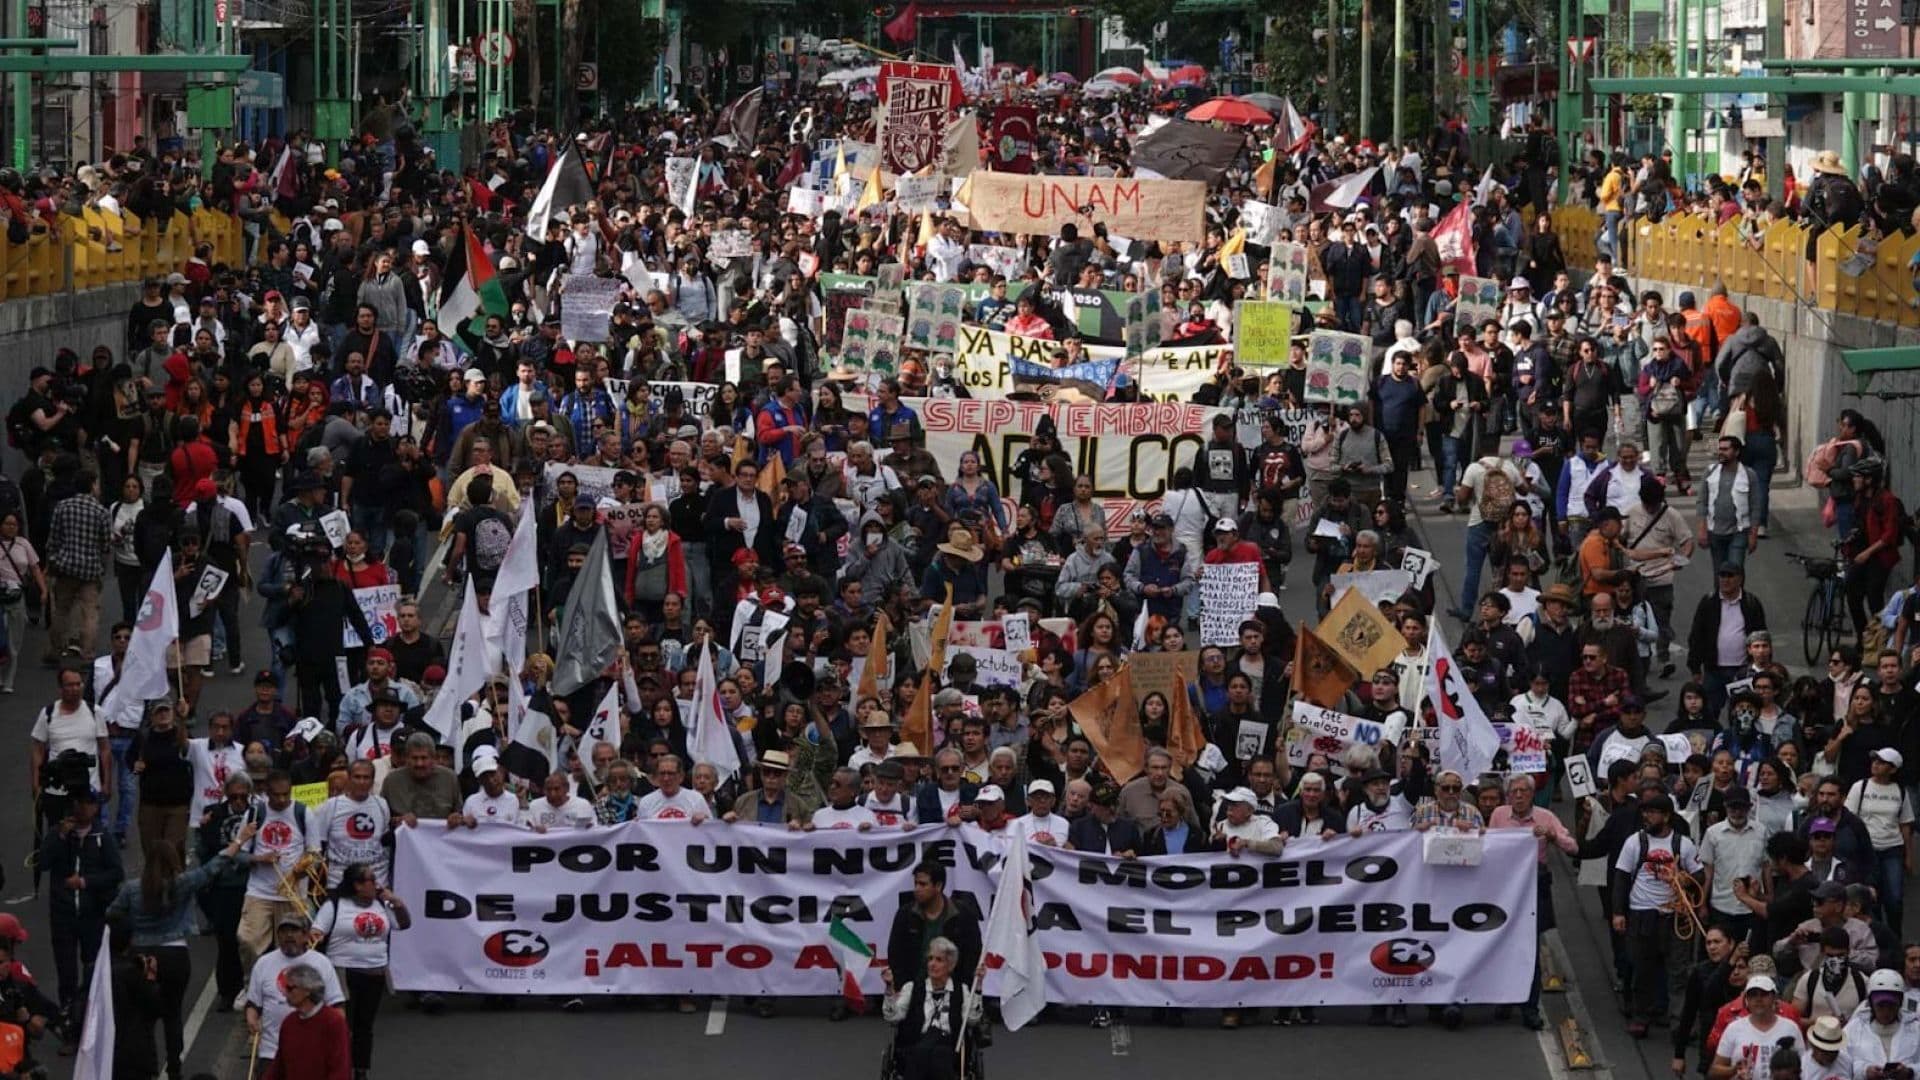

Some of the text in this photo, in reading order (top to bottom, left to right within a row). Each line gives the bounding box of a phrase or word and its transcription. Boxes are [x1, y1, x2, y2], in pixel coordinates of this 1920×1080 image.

[1023, 181, 1141, 218] UNAM
[961, 327, 994, 357] YA
[924, 400, 1211, 437] SEPTIEMBRE
[1353, 722, 1382, 747] NO
[511, 843, 661, 875] POR
[685, 845, 788, 875] UN
[1078, 855, 1399, 890] MODELO
[424, 889, 516, 923] DE
[541, 892, 876, 924] JUSTICIA
[1106, 906, 1192, 936] EL
[1215, 902, 1508, 938] PUEBLO
[584, 942, 775, 978] ¡ALTO
[985, 950, 1336, 983] UNIDAD!
